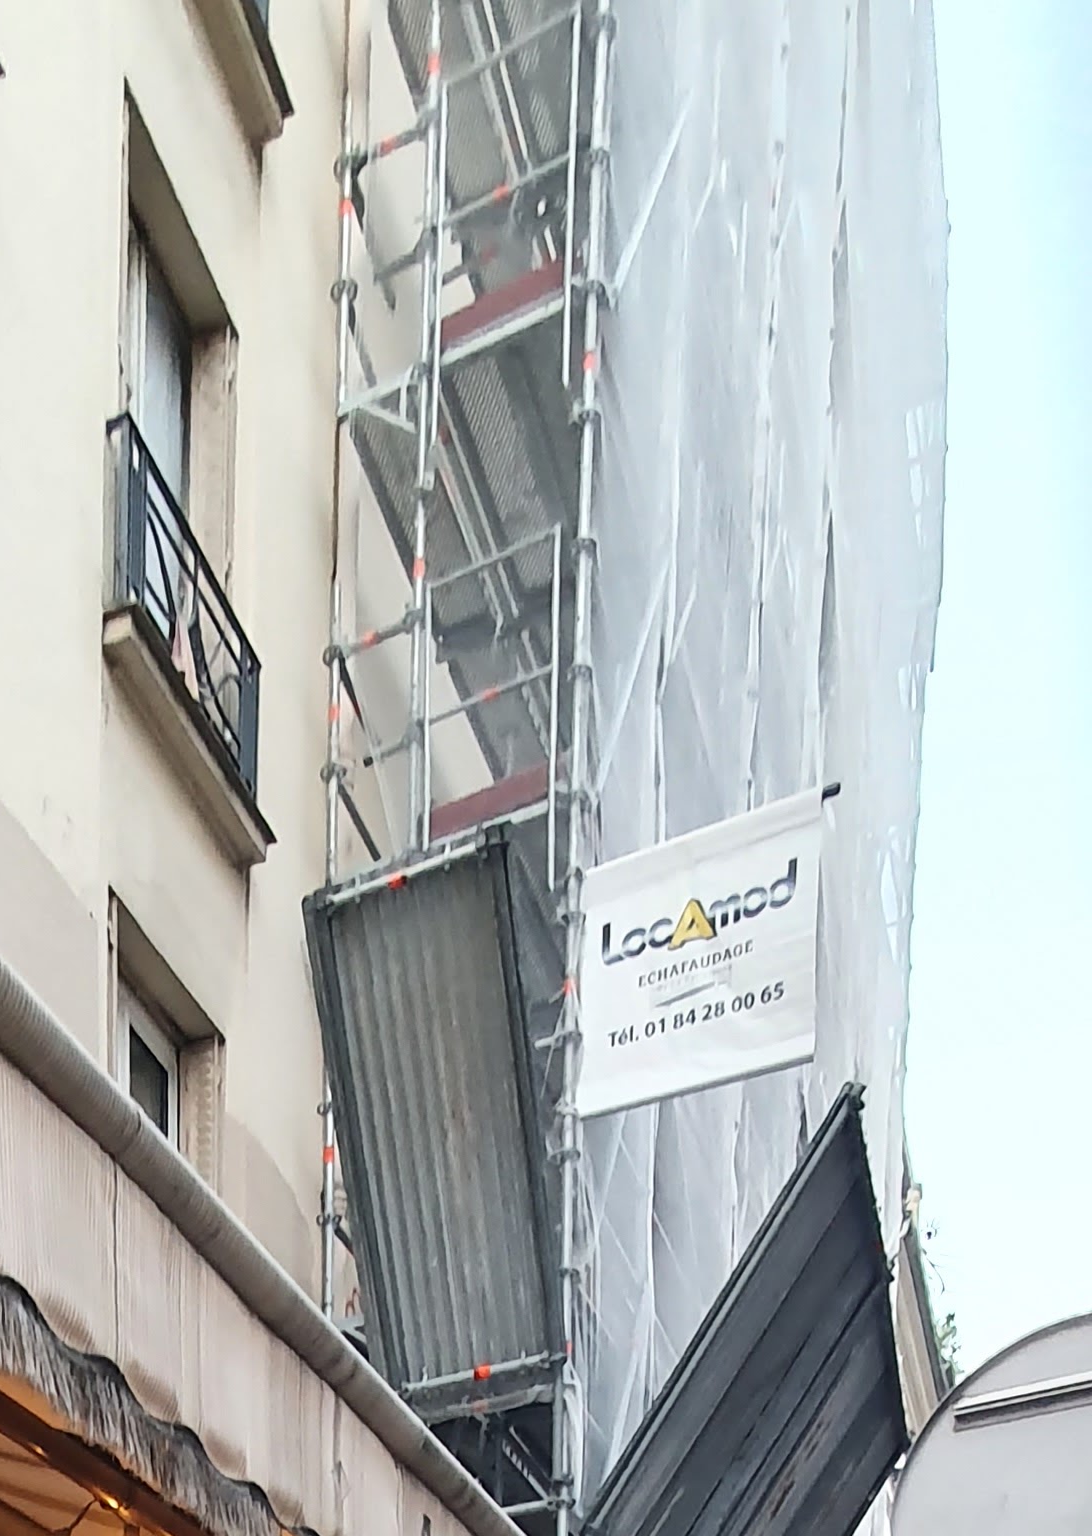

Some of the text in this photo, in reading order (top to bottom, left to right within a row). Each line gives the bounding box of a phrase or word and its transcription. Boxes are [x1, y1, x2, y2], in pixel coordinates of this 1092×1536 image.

[637, 939, 754, 988] ECHAFAUDAGE
[608, 980, 785, 1048] Tél. 01 84 28 00 65
